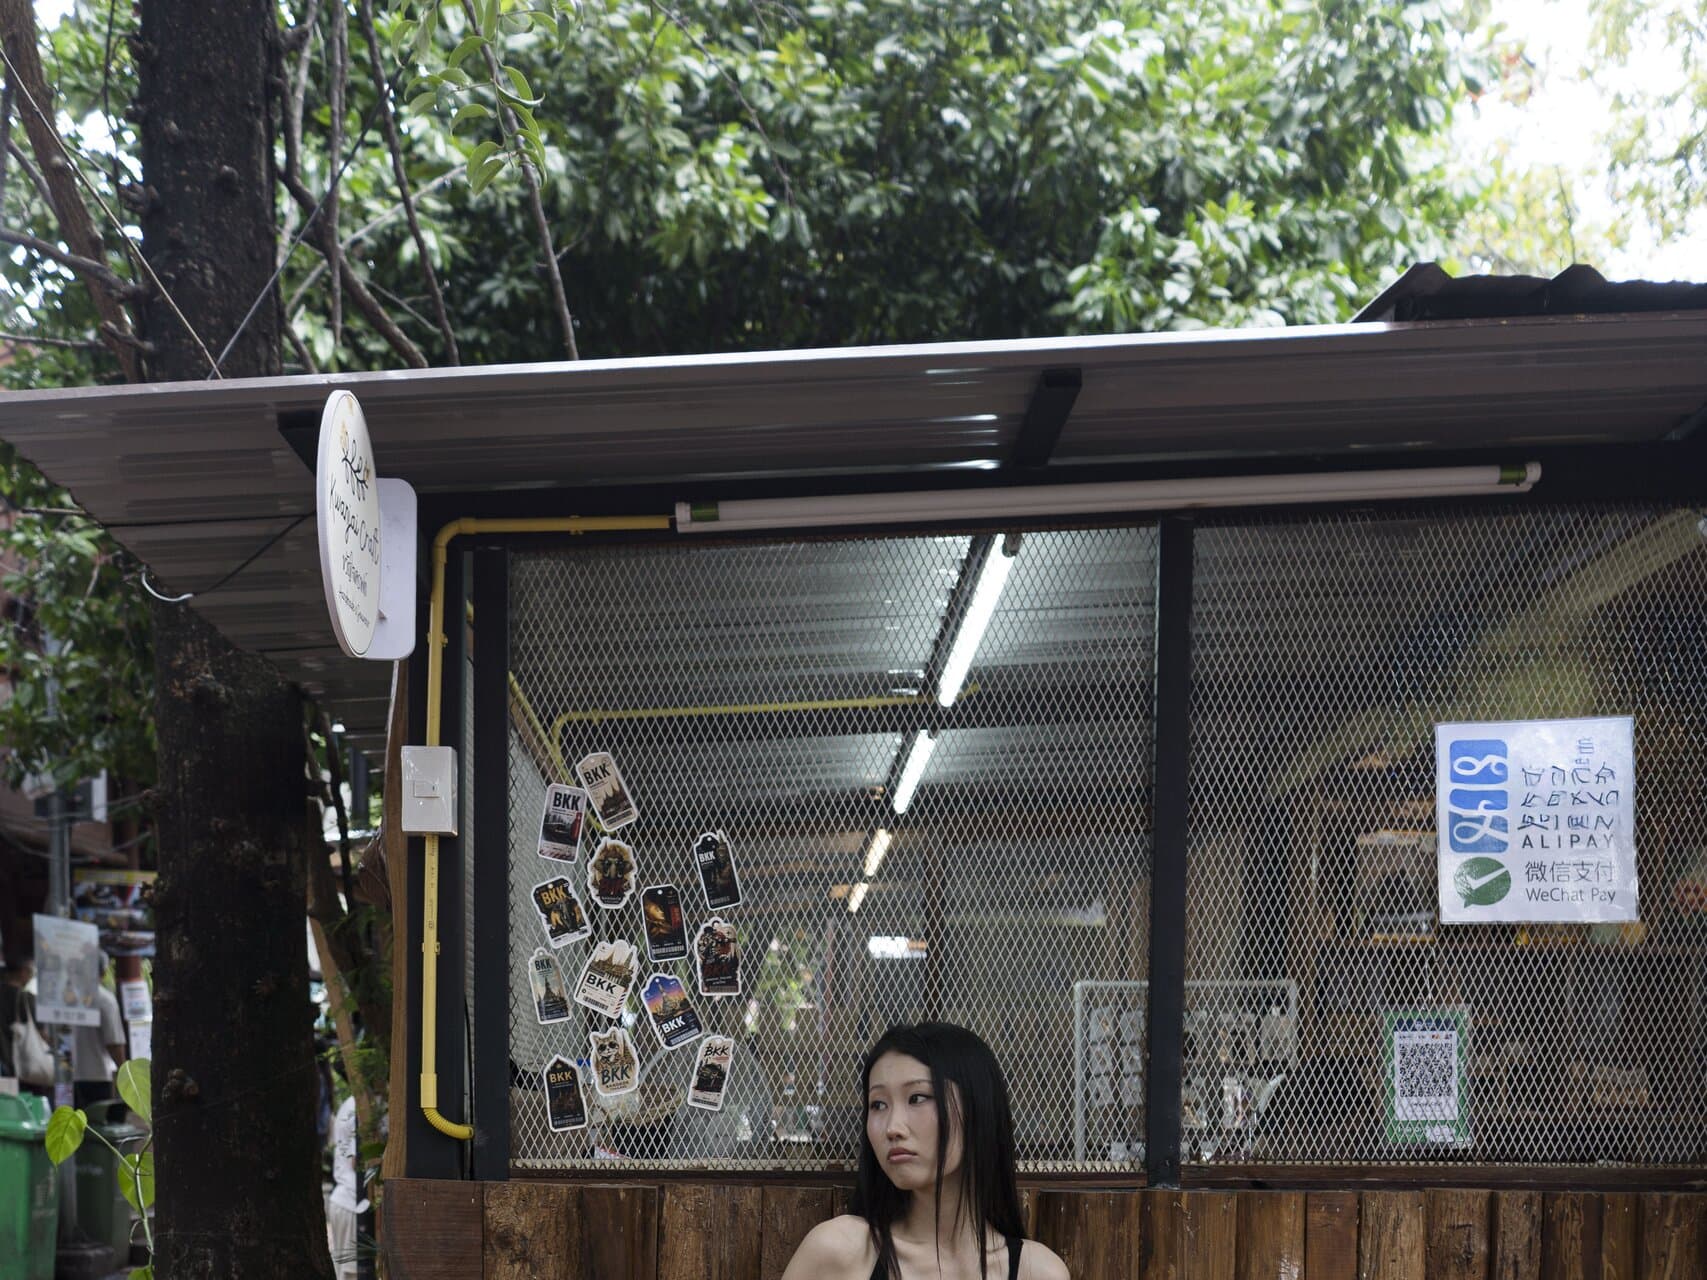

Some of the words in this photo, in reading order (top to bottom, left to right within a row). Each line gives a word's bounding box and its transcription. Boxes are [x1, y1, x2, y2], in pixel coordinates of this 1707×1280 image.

[359, 519, 380, 566] Craft
[584, 764, 611, 785] BKK
[553, 792, 581, 811] BKK
[1521, 834, 1614, 849] ALIPAY
[699, 851, 716, 863] BKK
[1525, 860, 1615, 883] 微信支付
[542, 887, 568, 905] BKK
[1525, 888, 1584, 902] WeChat
[1591, 888, 1616, 904] Pay
[535, 959, 552, 971] BKK
[586, 973, 616, 994] BKK
[662, 1016, 686, 1034] BKK
[704, 1043, 729, 1057] BKK
[550, 1071, 573, 1083] BKK
[602, 1066, 630, 1085] BKK
